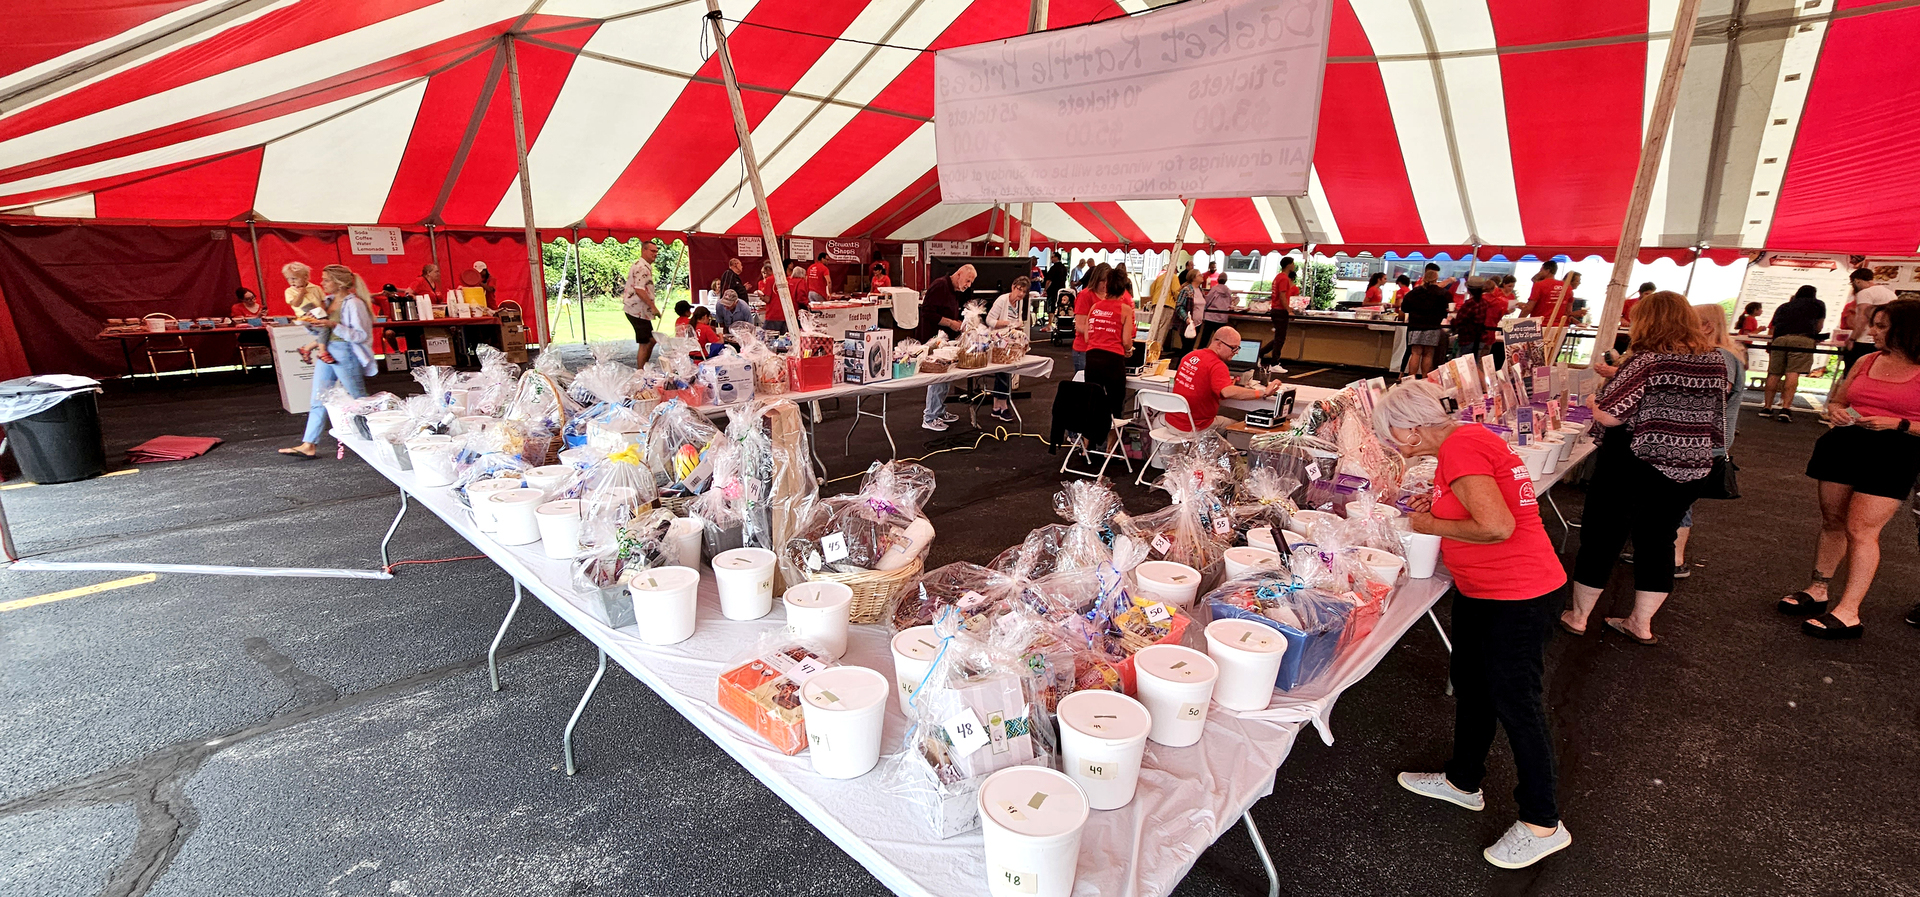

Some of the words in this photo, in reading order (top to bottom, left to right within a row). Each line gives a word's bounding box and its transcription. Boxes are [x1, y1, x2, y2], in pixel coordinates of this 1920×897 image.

[848, 313, 859, 321] Fried
[860, 312, 872, 321] Dough
[1216, 520, 1226, 529] 55
[828, 541, 841, 552] 45
[1155, 538, 1165, 549] 53
[1149, 606, 1163, 618] 50
[801, 663, 816, 674] 47
[902, 682, 913, 694] 46
[1188, 707, 1200, 716] 50
[957, 722, 974, 739] 48
[1089, 765, 1103, 776] 49
[1005, 871, 1021, 886] 48
